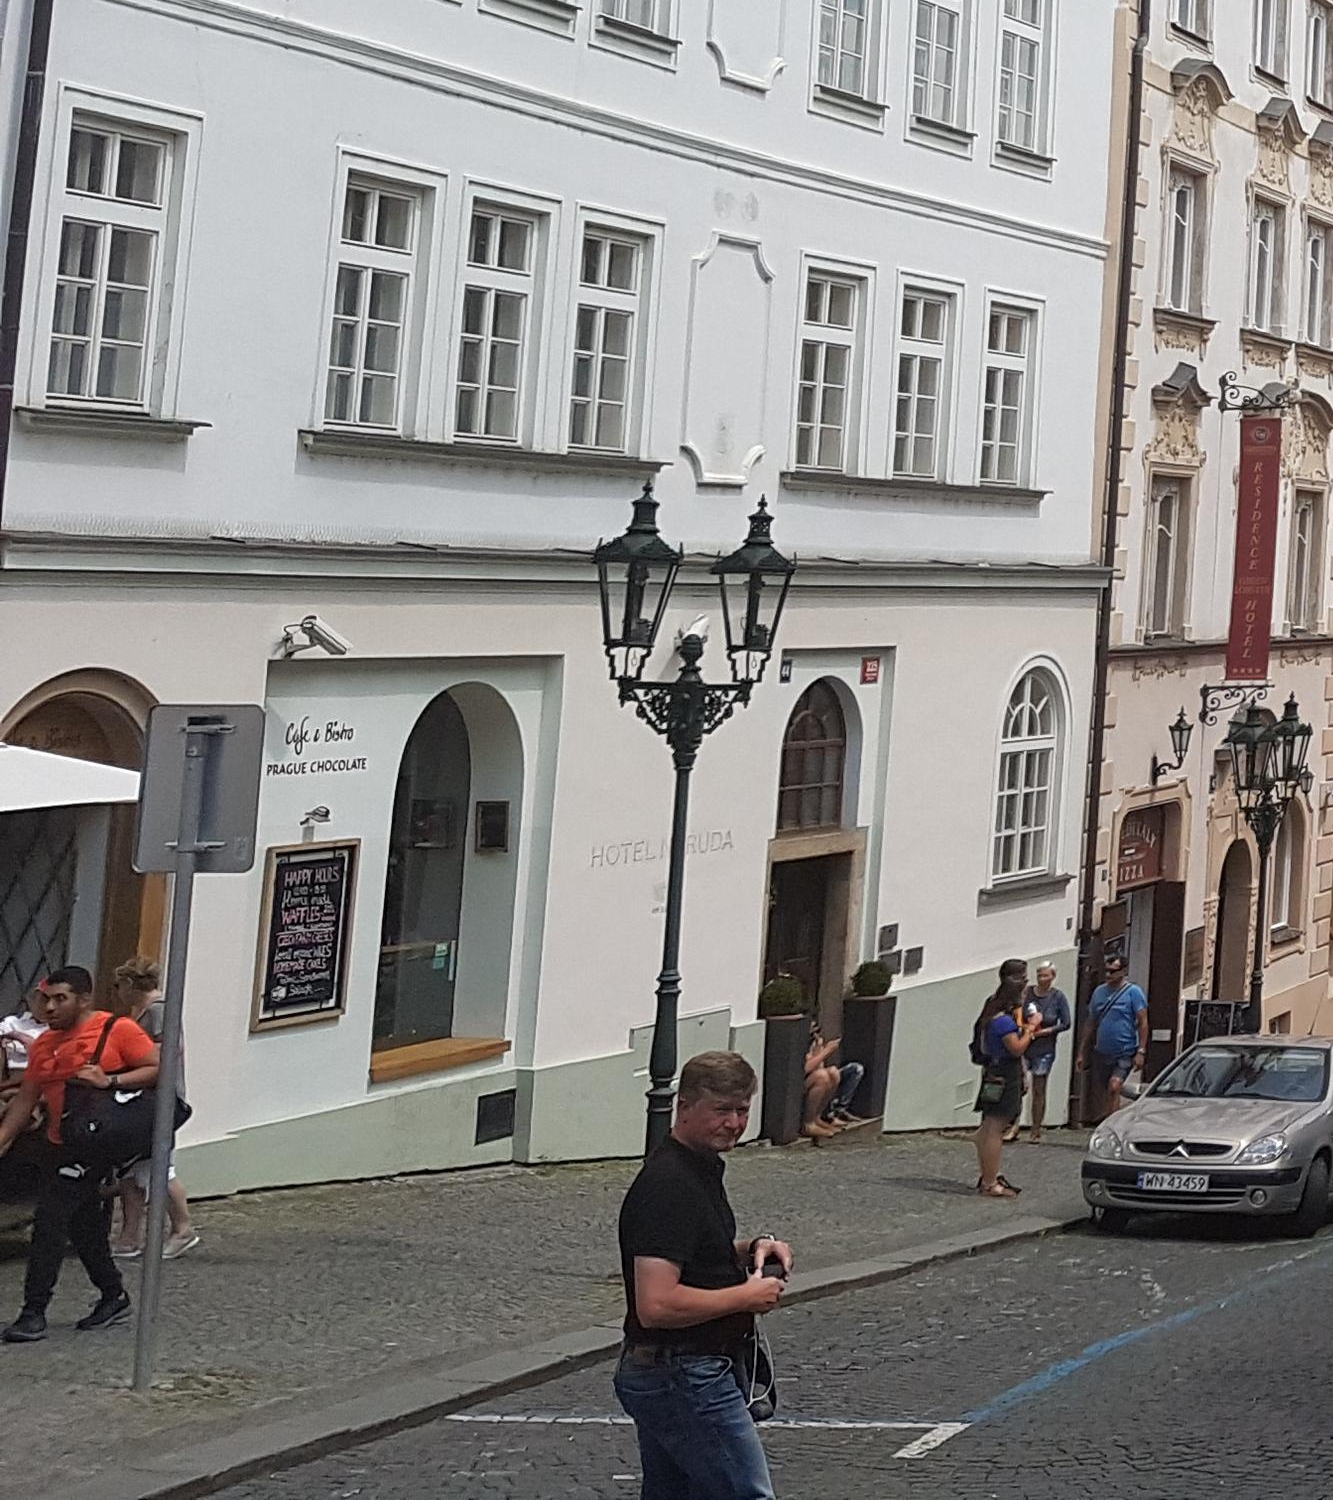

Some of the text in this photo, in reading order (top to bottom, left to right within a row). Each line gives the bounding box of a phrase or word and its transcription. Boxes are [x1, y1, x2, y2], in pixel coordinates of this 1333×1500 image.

[1249, 461, 1263, 570] RESIDENCE
[1242, 600, 1256, 659] HOTEL
[325, 721, 354, 743] Bistro
[266, 758, 367, 777] PRAGUE CHOCOLATE
[591, 829, 734, 868] HOTEL NRUDA
[1119, 865, 1144, 882] IZZA
[1145, 1174, 1205, 1190] WN 43459
